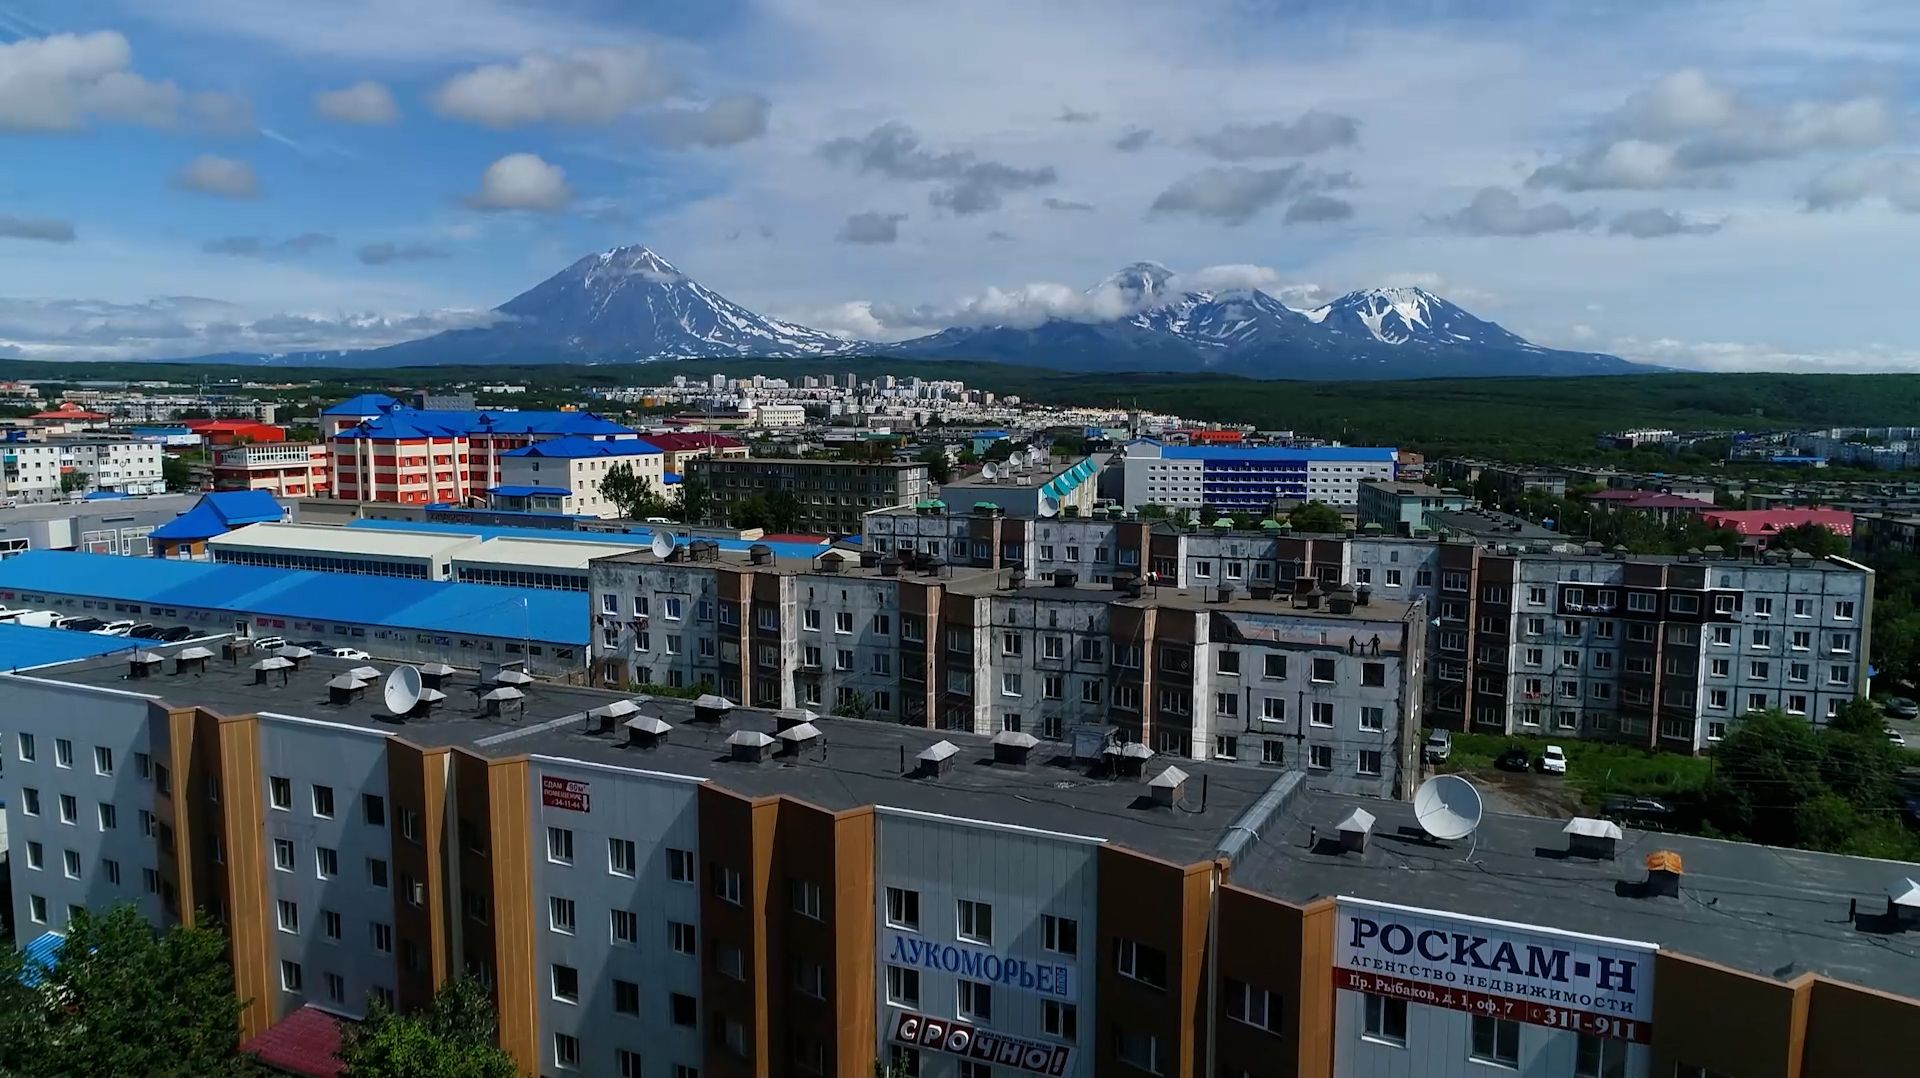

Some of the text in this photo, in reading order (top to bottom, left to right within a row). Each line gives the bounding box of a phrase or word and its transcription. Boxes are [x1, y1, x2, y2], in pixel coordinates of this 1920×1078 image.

[890, 935, 1054, 994] ЛУКОМОРЬЕ
[1350, 955, 1634, 1014] АГЕНТСТВО НЕДВИЖИМОСТИ
[1350, 974, 1635, 1039] Пр. Рыбаков, д. 1, оф. 7 311-911
[900, 1018, 1064, 1071] СРОЧНО!
